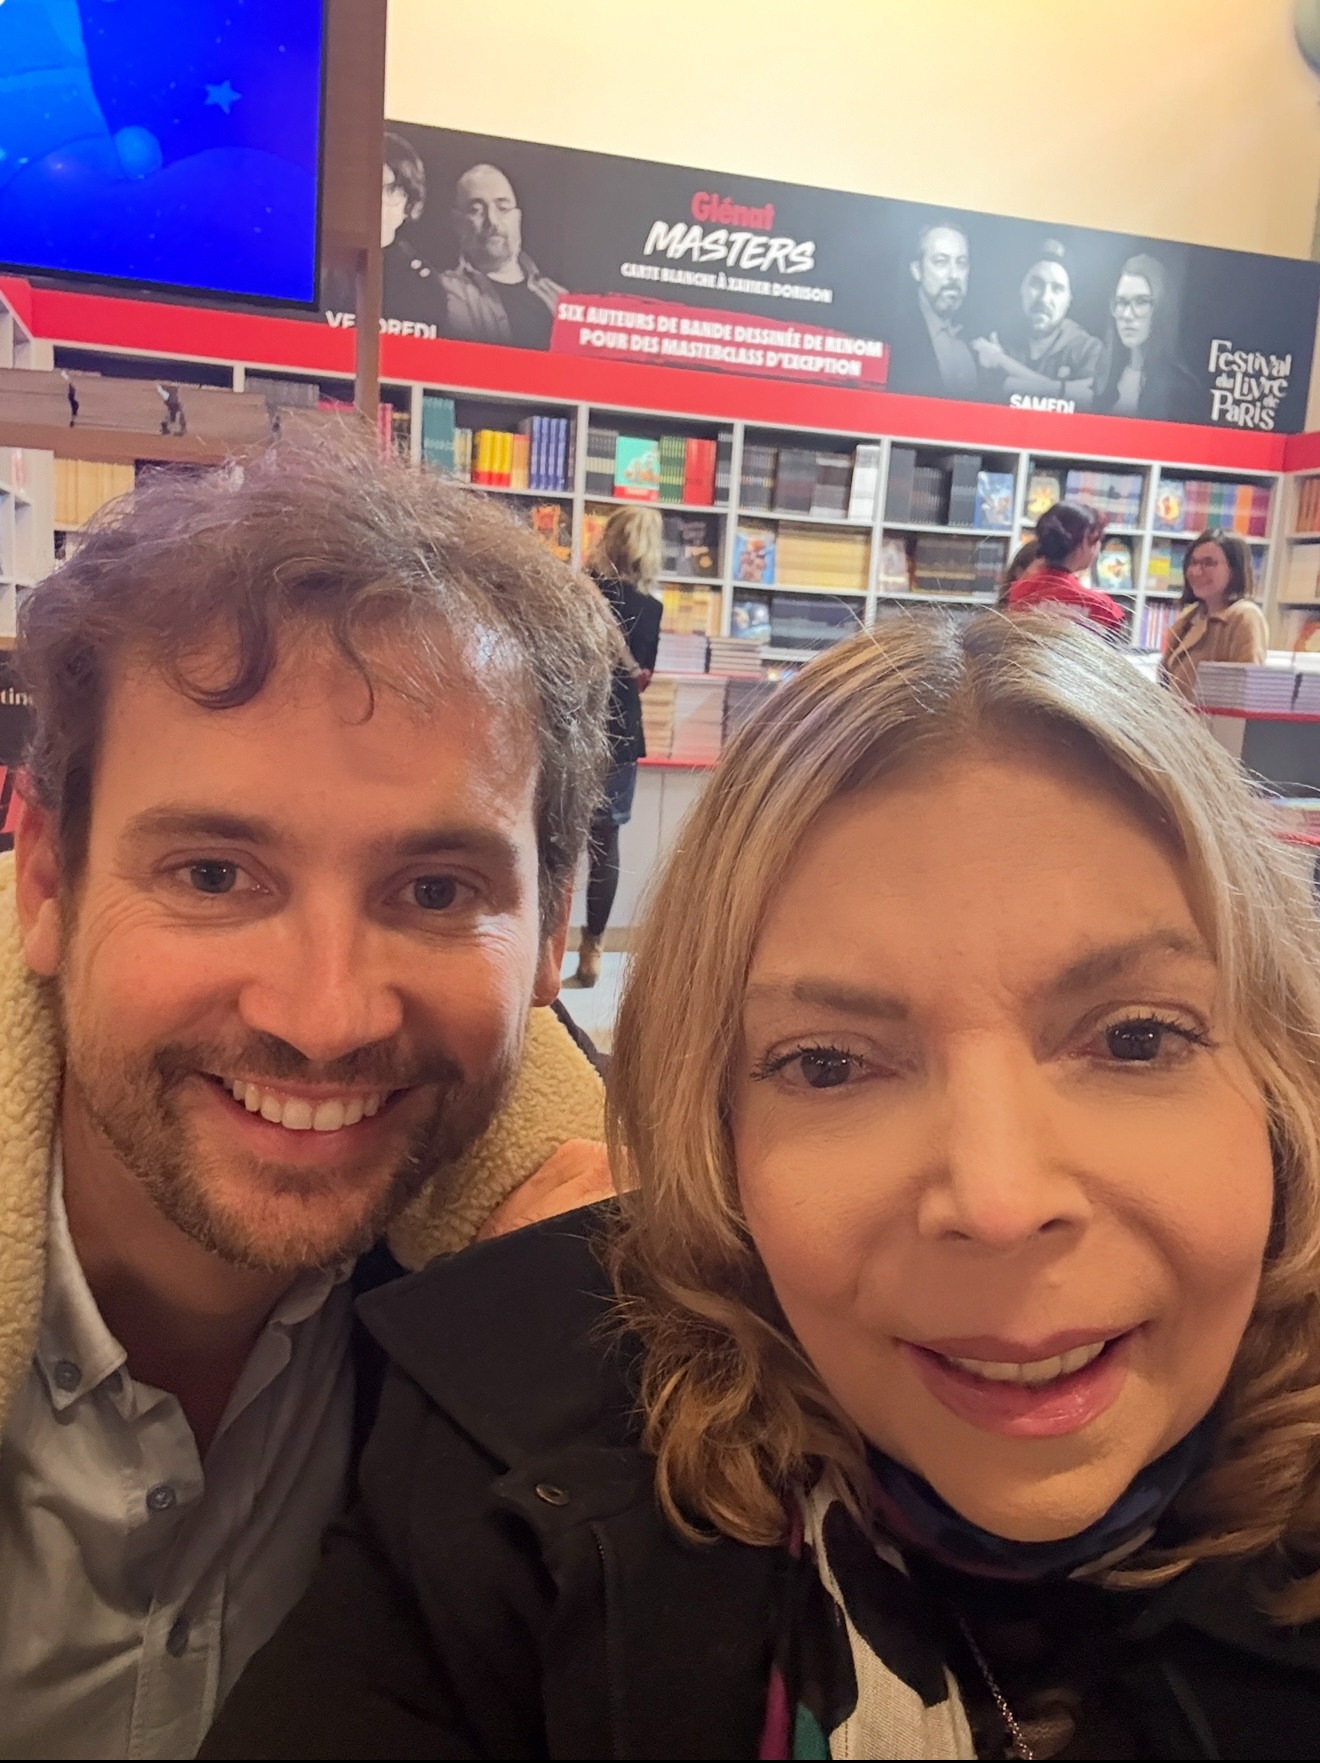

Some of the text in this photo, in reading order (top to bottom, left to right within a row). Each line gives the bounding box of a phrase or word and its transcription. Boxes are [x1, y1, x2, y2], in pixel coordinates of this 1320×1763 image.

[691, 191, 776, 231] Glénat
[643, 220, 816, 274] MASTERS
[620, 262, 661, 281] CARTE
[660, 268, 717, 287] BLANCHE
[717, 271, 729, 290] À
[325, 310, 438, 340] VEREDI
[558, 303, 884, 358] SIX AUTEURS DE BANDE DESSINÉE DE RENOM
[579, 328, 862, 377] POUR DES MASTERCLASS D'EXCEPTION
[1208, 339, 1292, 377] Festival
[1009, 394, 1076, 415] SAMEDI
[1234, 371, 1288, 401] Livre
